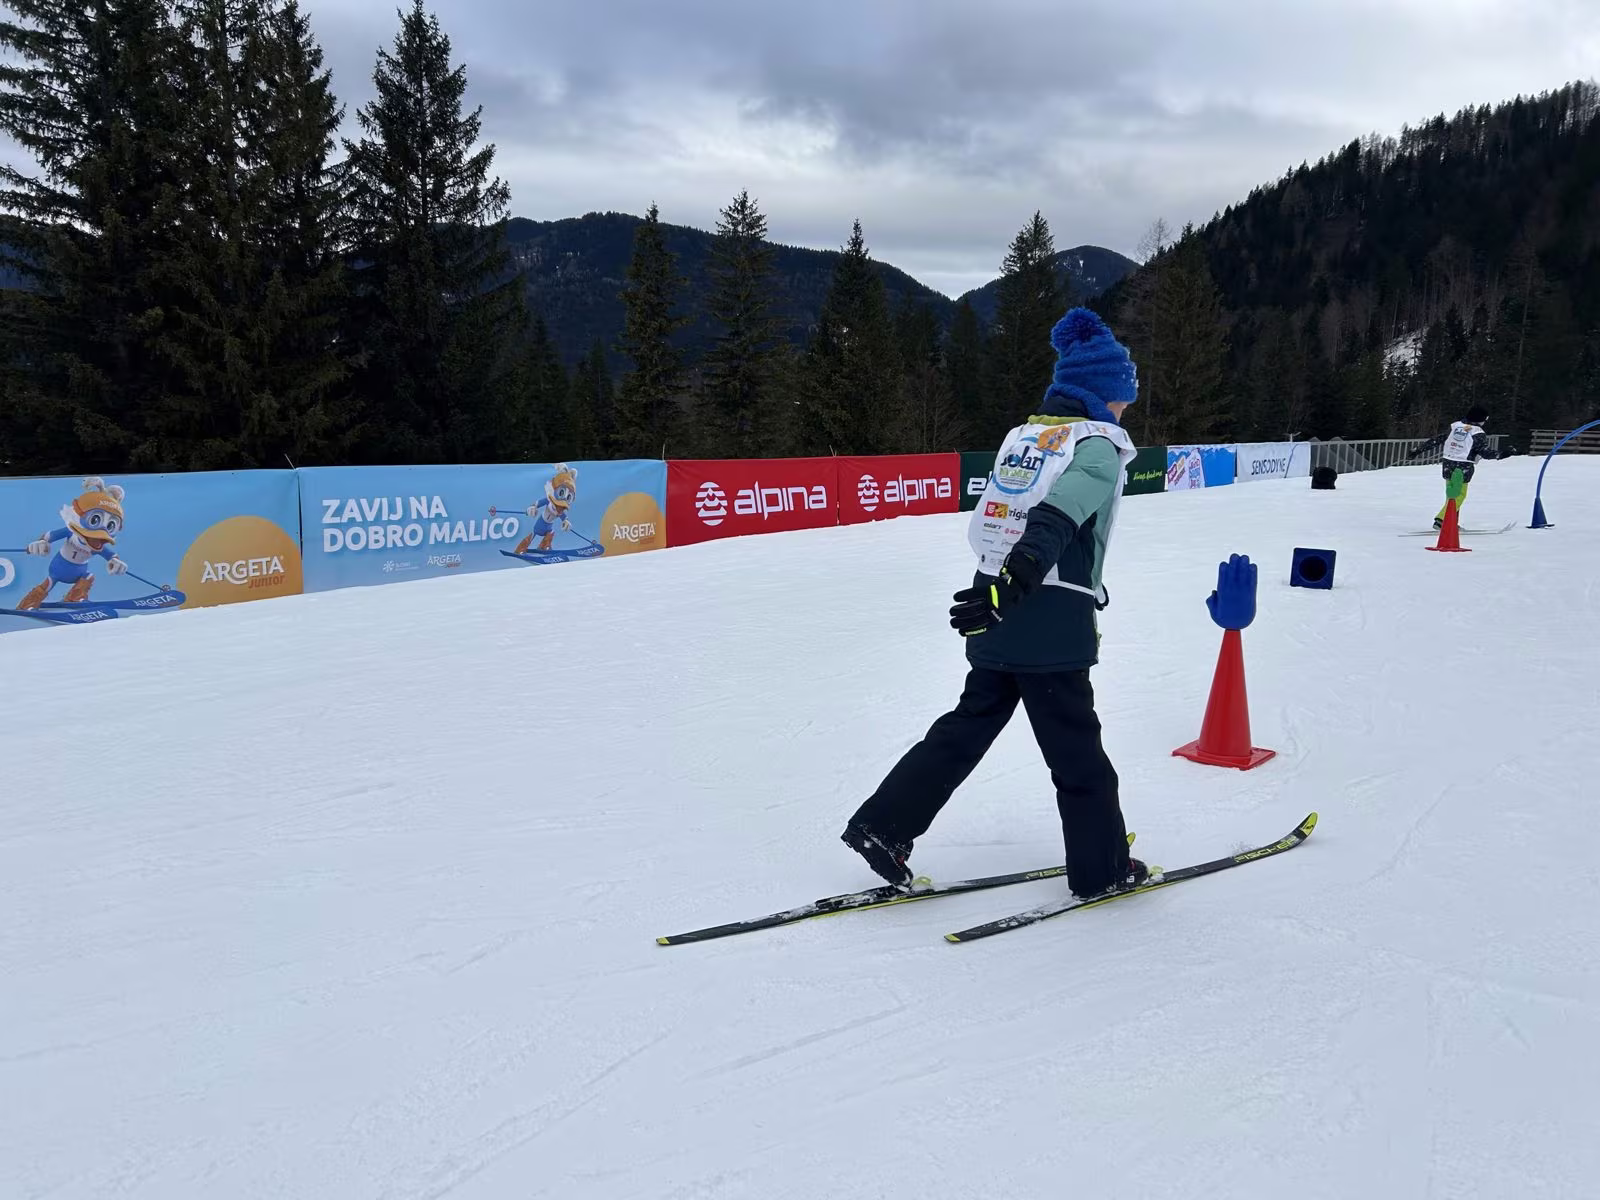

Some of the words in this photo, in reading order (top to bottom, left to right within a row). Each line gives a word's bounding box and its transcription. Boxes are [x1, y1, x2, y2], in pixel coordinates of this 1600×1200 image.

[1251, 457, 1286, 475] SENSODYNE
[734, 481, 827, 520] alpina
[884, 473, 952, 507] alpina
[321, 496, 403, 524] ZAVIJ
[409, 495, 448, 519] NA
[323, 523, 424, 553] DOBRO
[429, 517, 520, 544] MALICO
[613, 522, 656, 543] ARGETA
[200, 555, 285, 585] ARGETA
[427, 553, 462, 567] ARGETA
[135, 594, 177, 608] ARGETA
[69, 610, 109, 622] ARGETA
[1234, 834, 1298, 863] FISCHER
